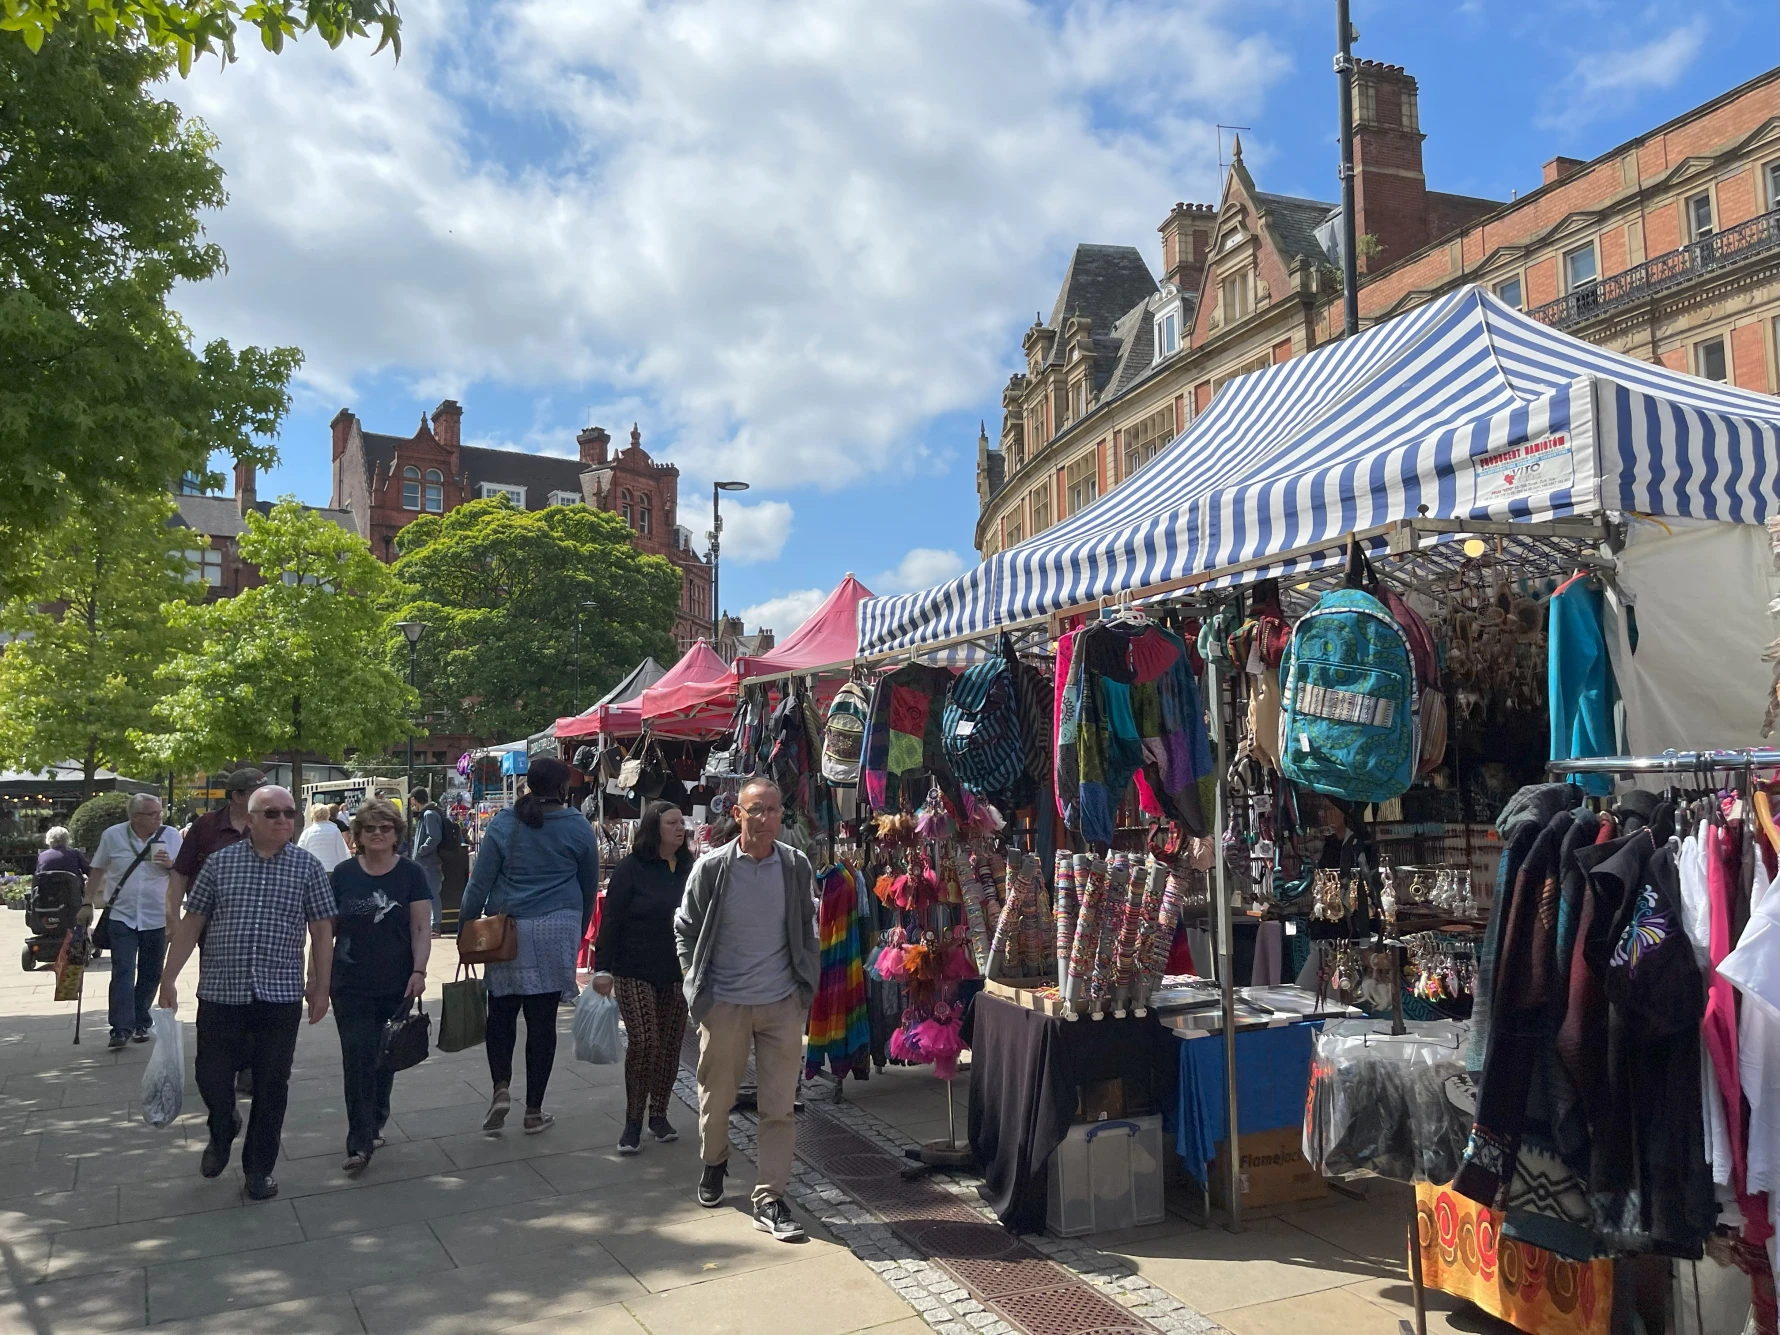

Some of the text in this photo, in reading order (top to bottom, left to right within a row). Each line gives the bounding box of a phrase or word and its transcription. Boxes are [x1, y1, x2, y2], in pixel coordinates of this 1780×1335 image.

[1480, 448, 1520, 468] PRODUCENT
[1524, 436, 1564, 455] NAMIOTÓW
[1512, 463, 1540, 476] VITO
